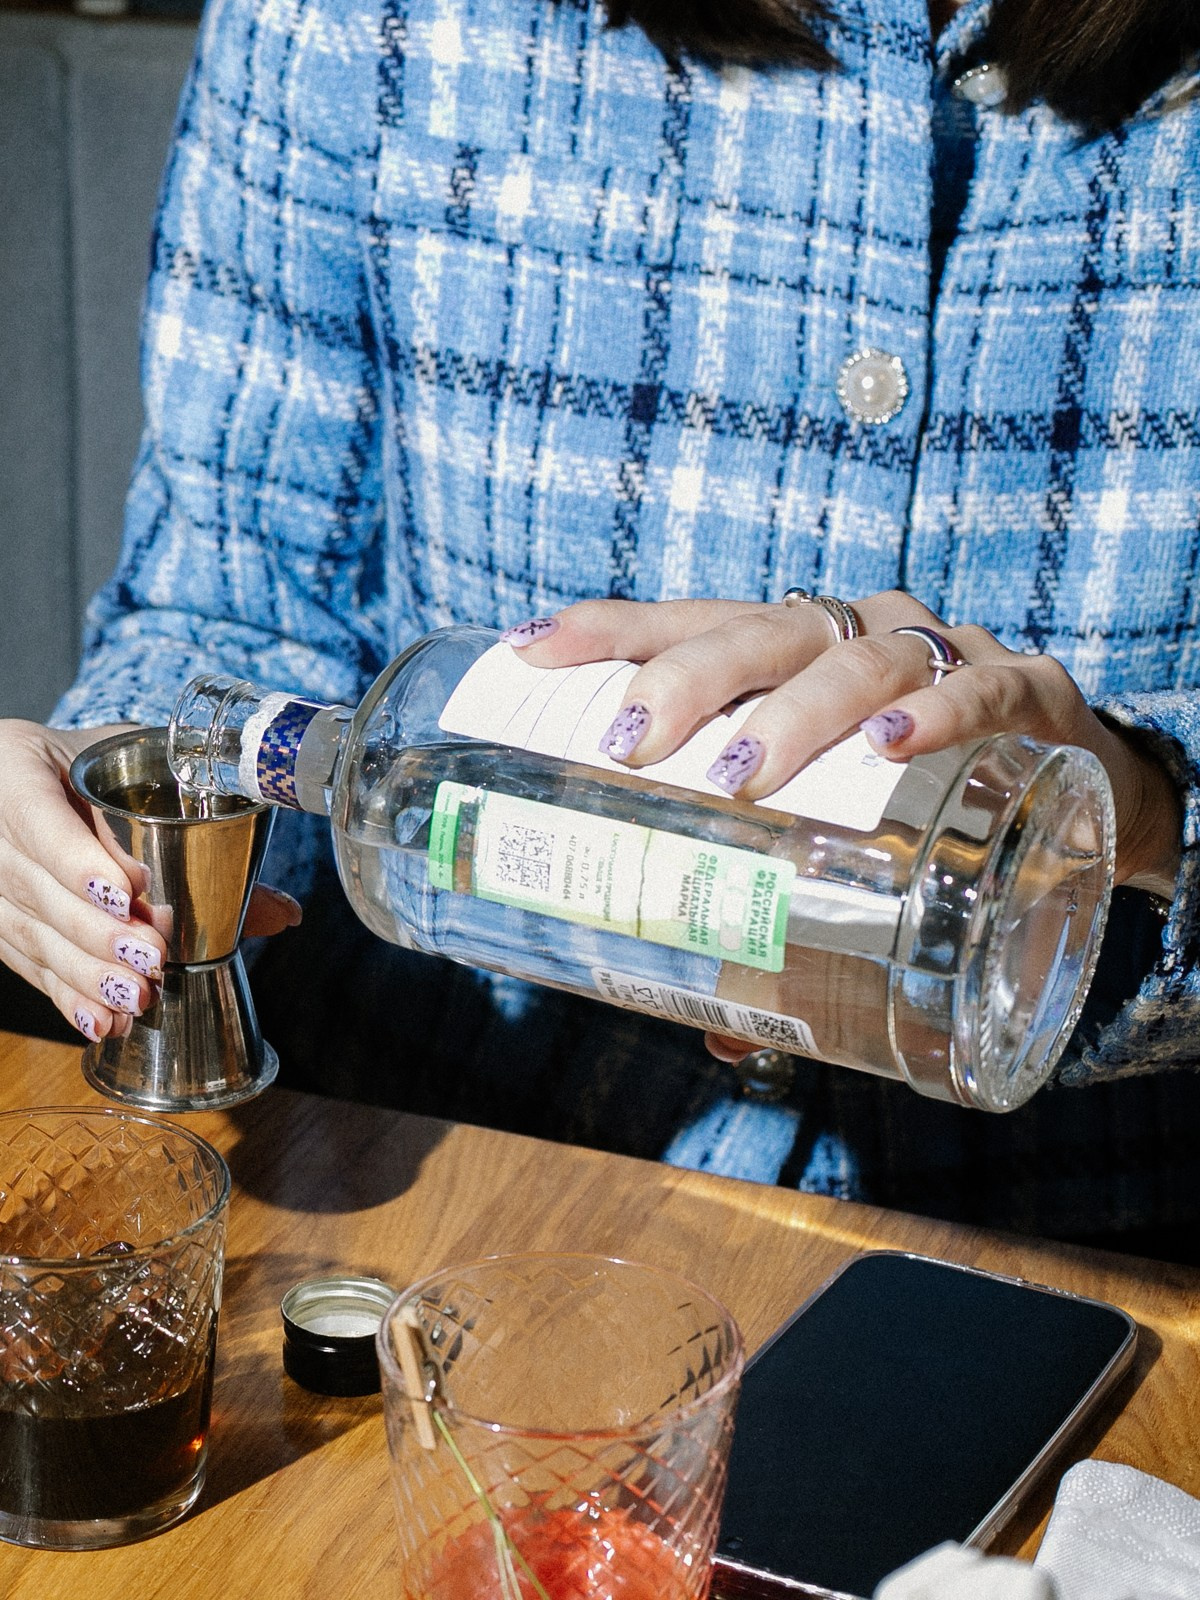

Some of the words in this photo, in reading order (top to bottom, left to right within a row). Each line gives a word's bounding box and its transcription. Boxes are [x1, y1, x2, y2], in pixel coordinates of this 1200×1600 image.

[678, 874, 691, 917] МАРКА
[688, 853, 707, 942] СПЕЦИАЛЬНАЯ
[699, 856, 718, 946] ФЕДЕРАЛЬНАЯ
[747, 870, 766, 955] ФЕДЕРАЦИЯ
[758, 872, 777, 957] РОССИЙСКАЯ
